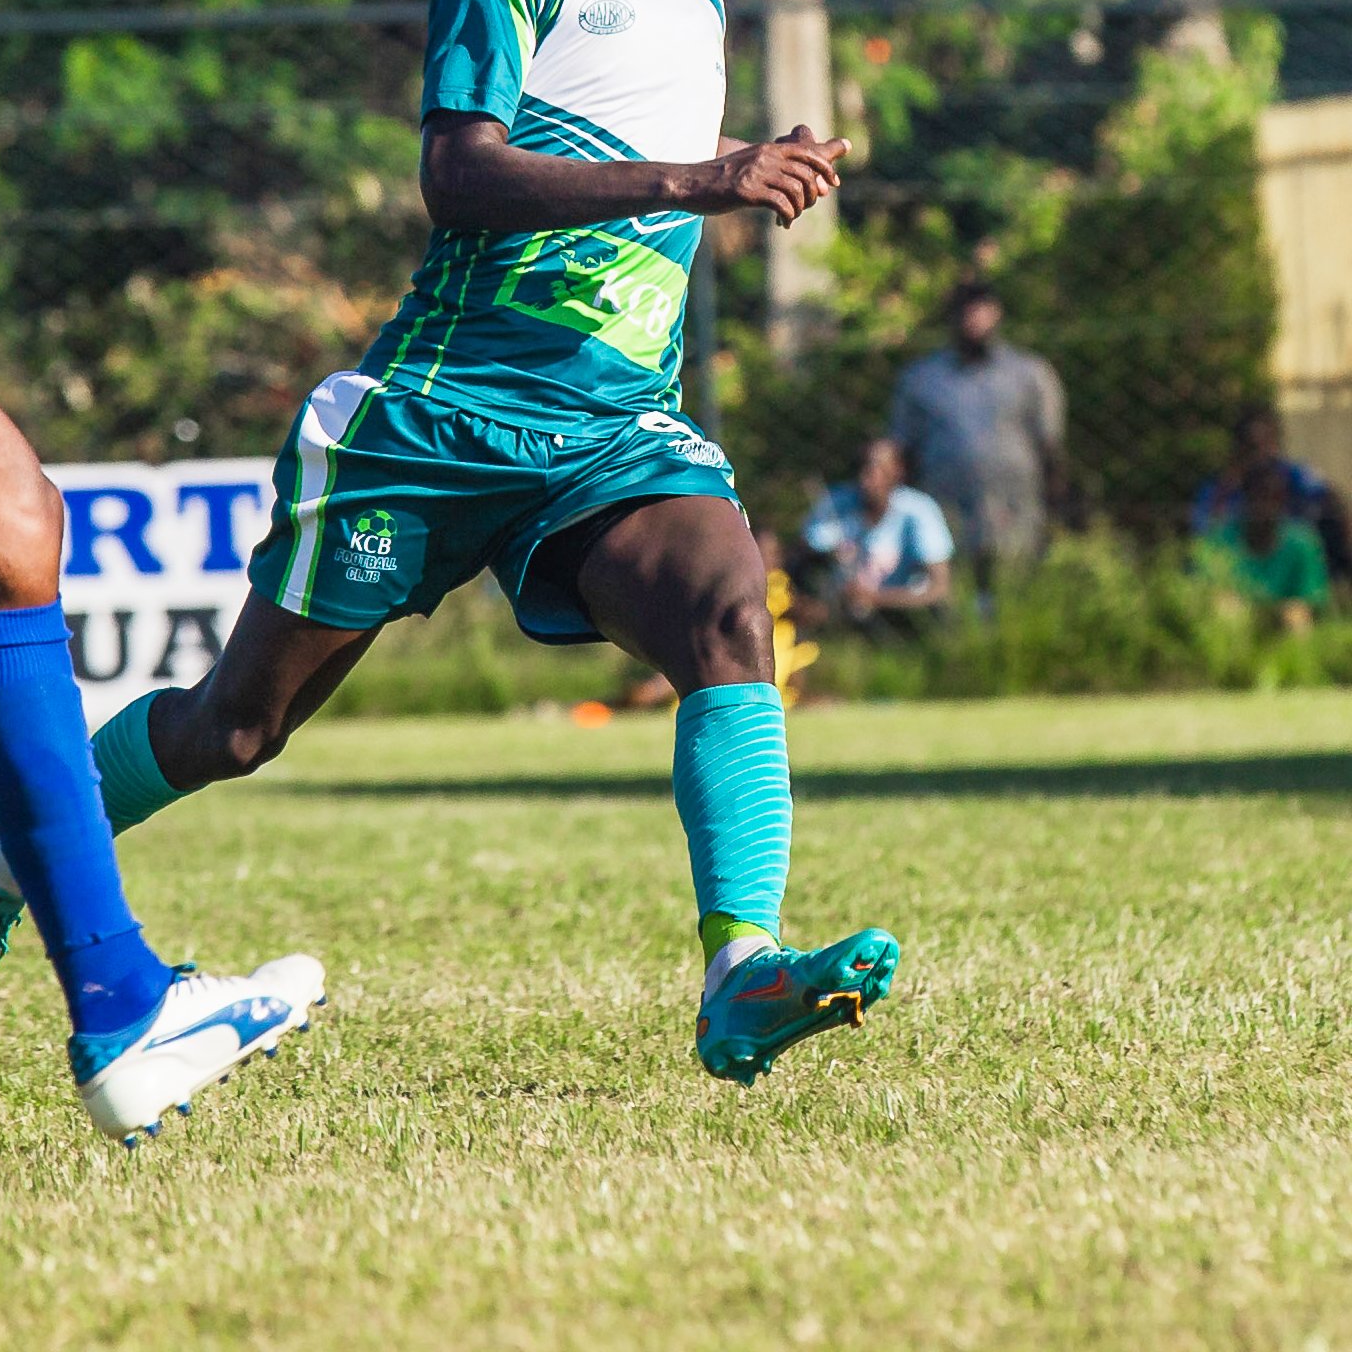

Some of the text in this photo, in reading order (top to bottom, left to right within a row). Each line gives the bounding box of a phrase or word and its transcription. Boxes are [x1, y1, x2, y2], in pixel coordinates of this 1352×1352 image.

[592, 269, 672, 339] KCB
[350, 531, 392, 555] KCB
[334, 547, 398, 571] FOOTBALL
[345, 567, 381, 583] CLUB
